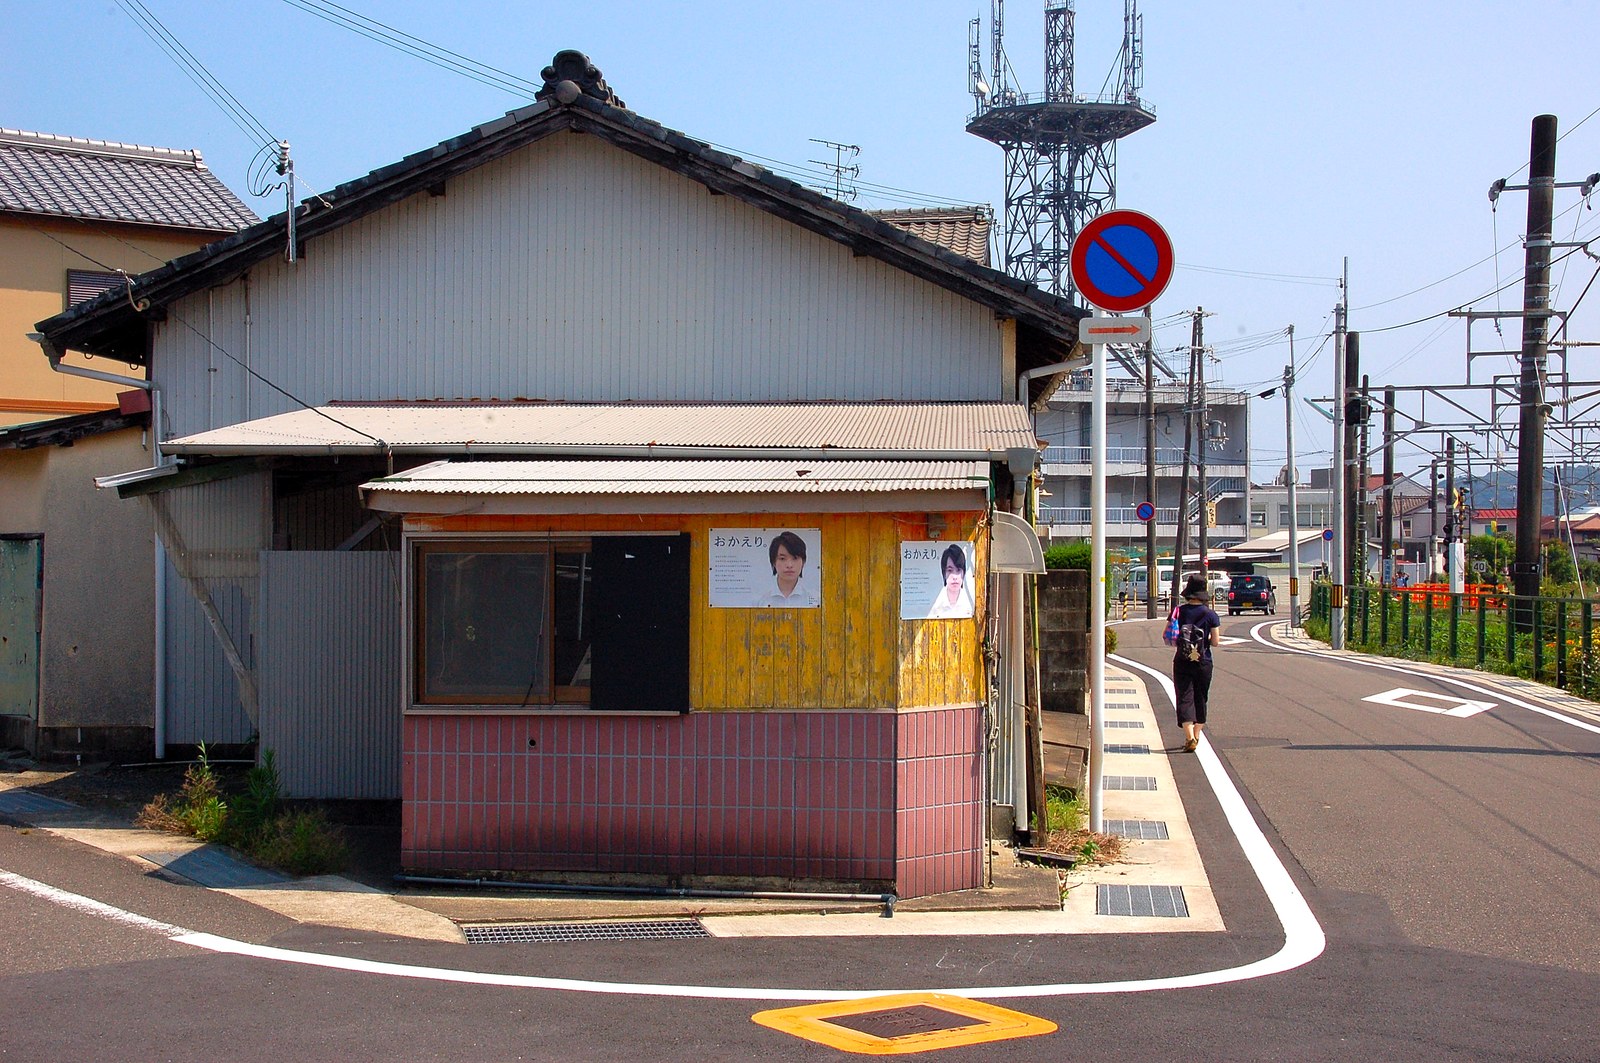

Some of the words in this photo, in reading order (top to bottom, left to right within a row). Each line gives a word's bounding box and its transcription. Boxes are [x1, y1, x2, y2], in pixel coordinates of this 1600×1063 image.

[714, 535, 768, 549] おかえり。
[1473, 562, 1485, 571] 40
